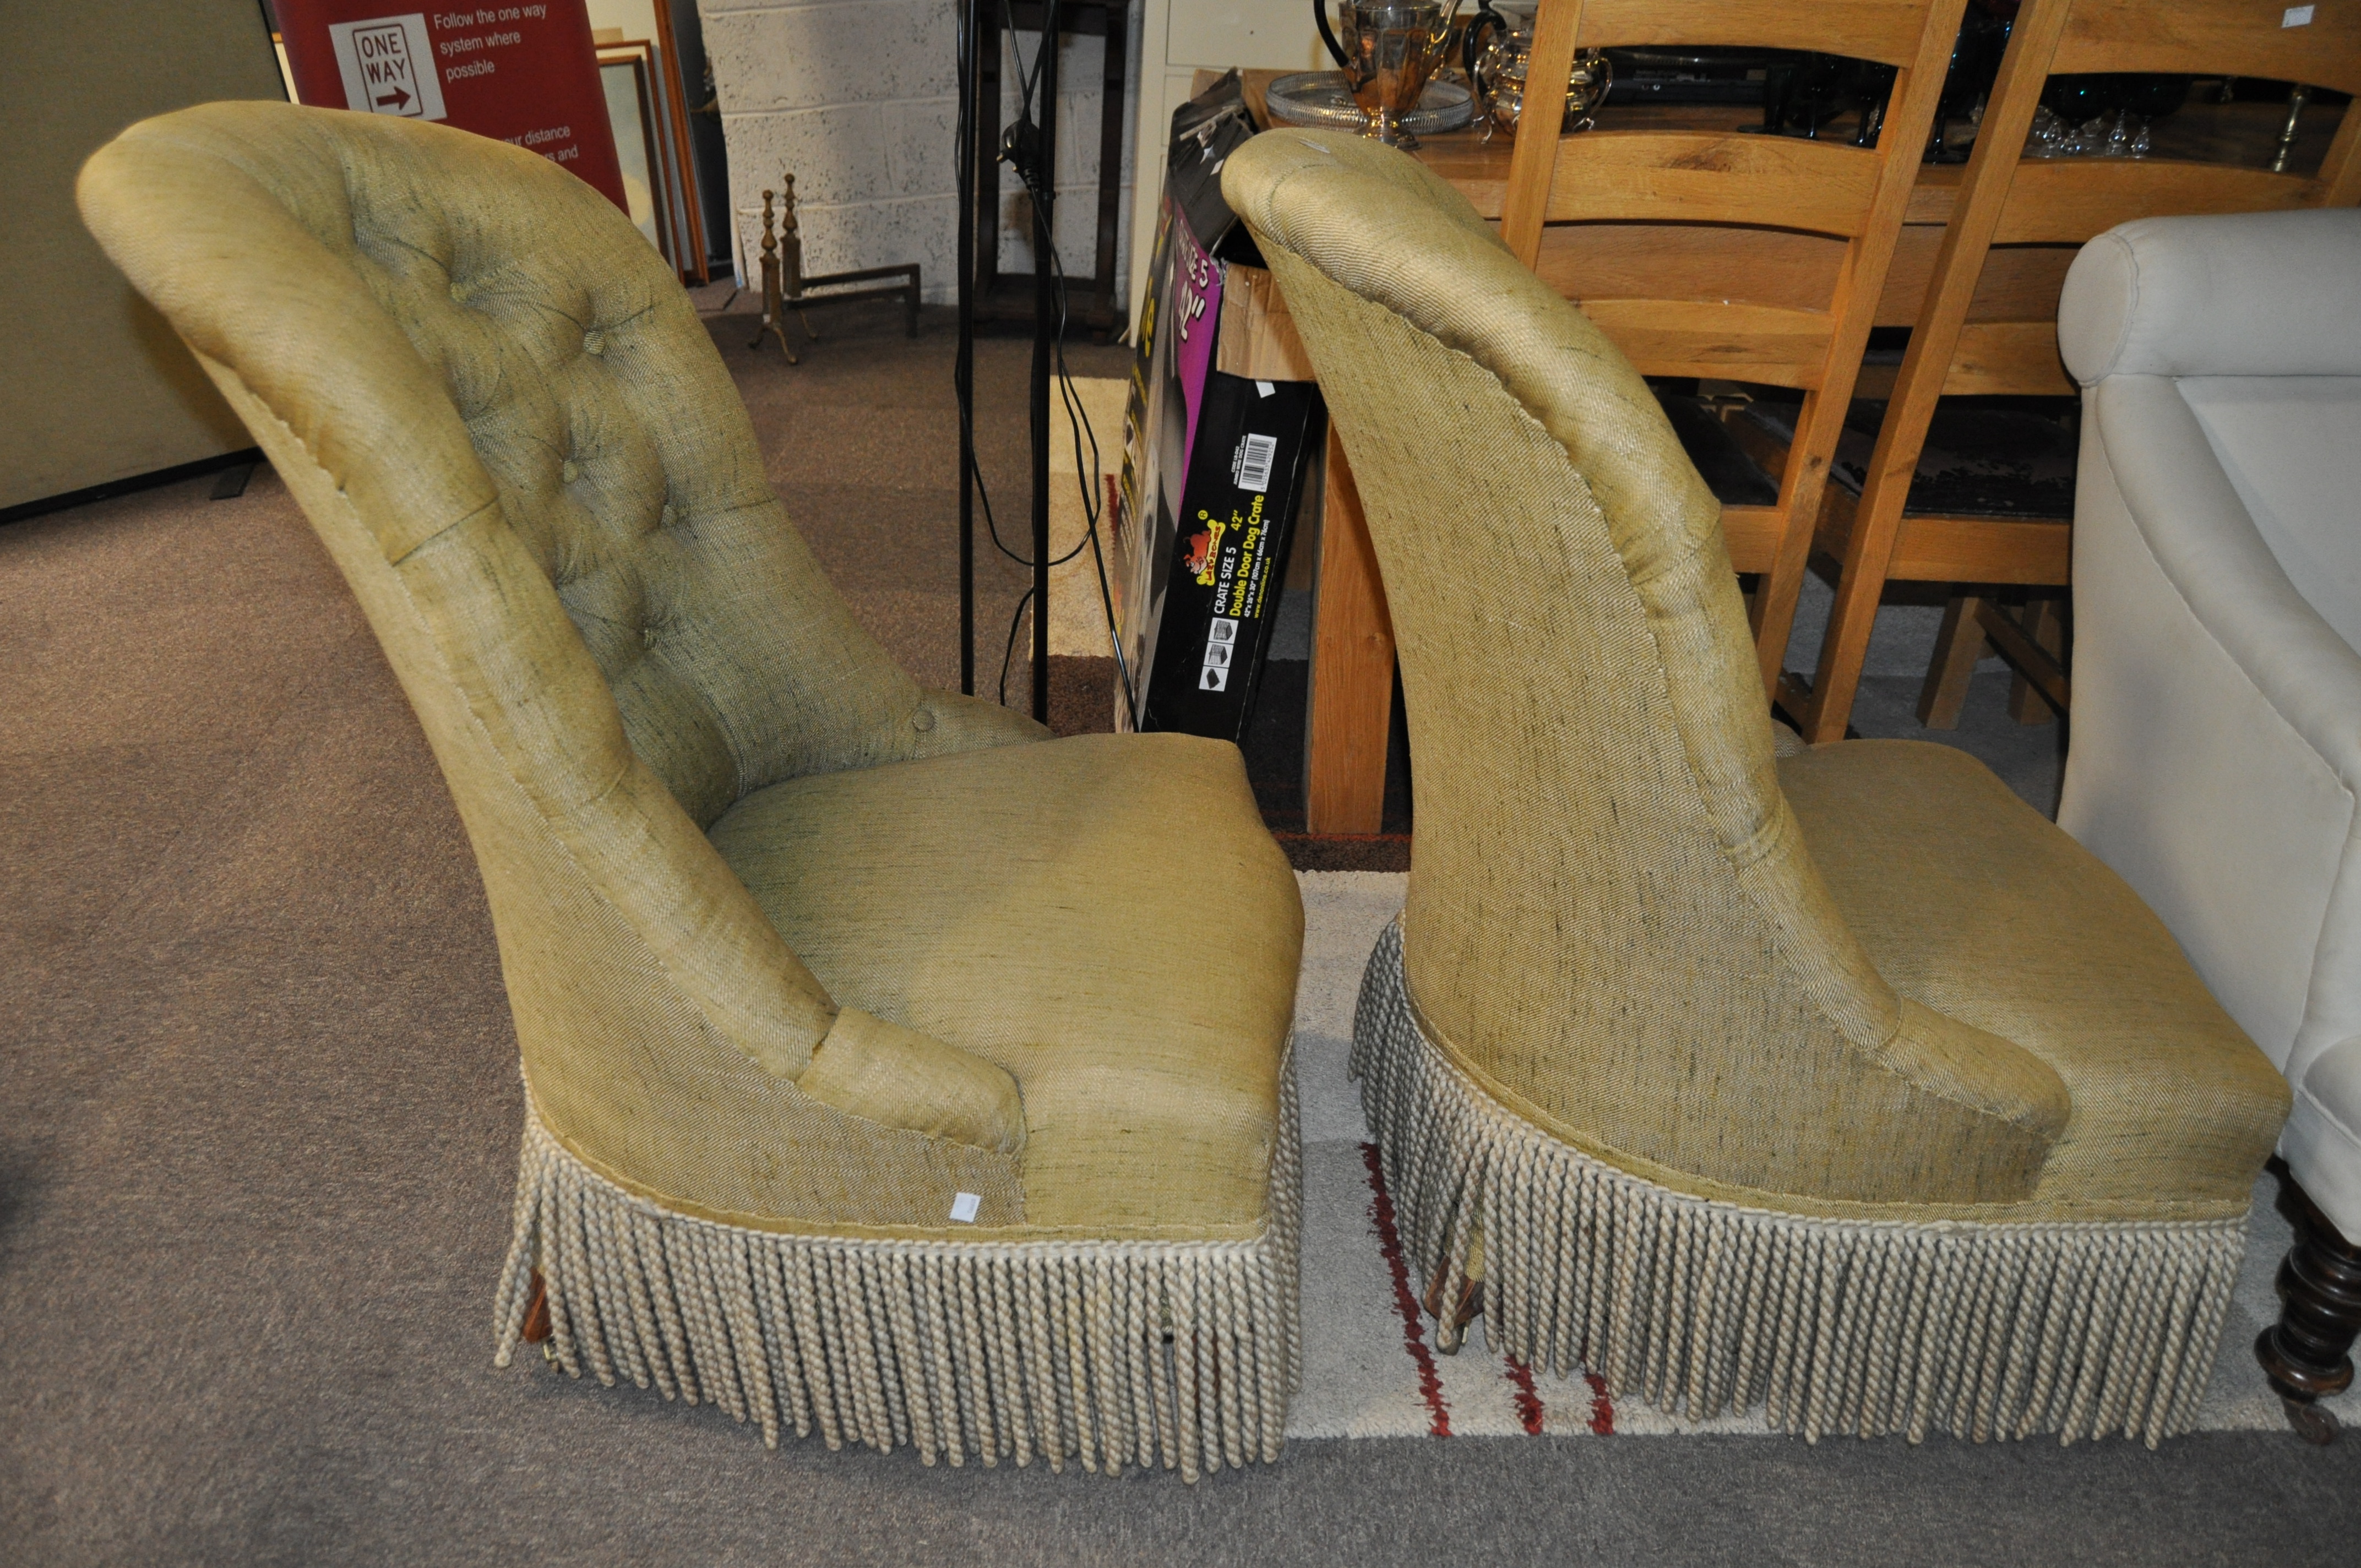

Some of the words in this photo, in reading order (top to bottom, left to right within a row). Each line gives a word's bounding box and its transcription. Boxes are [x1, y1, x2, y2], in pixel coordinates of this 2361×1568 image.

[433, 14, 474, 30] Follow
[477, 10, 496, 25] the
[498, 8, 520, 21] one
[522, 3, 547, 20] way
[361, 33, 402, 58] ONE
[440, 34, 483, 56] system
[485, 31, 521, 46] where
[366, 58, 407, 84] WAY
[445, 63, 495, 84] possible
[525, 126, 570, 146] distance
[558, 144, 579, 162] and
[1199, 259, 1209, 288] 5
[1248, 495, 1264, 525] Crate
[1210, 526, 1221, 559] BONES
[1243, 527, 1260, 549] Dog
[1252, 562, 1260, 580] (107cm
[1256, 541, 1265, 556] 66cm
[1261, 519, 1270, 535] 76cm)
[1221, 556, 1234, 579] SIZE
[1237, 551, 1252, 578] Door
[1214, 581, 1230, 614] CRATE
[1230, 580, 1247, 616] Double
[1254, 557, 1271, 618] www.denonline.co.uk
